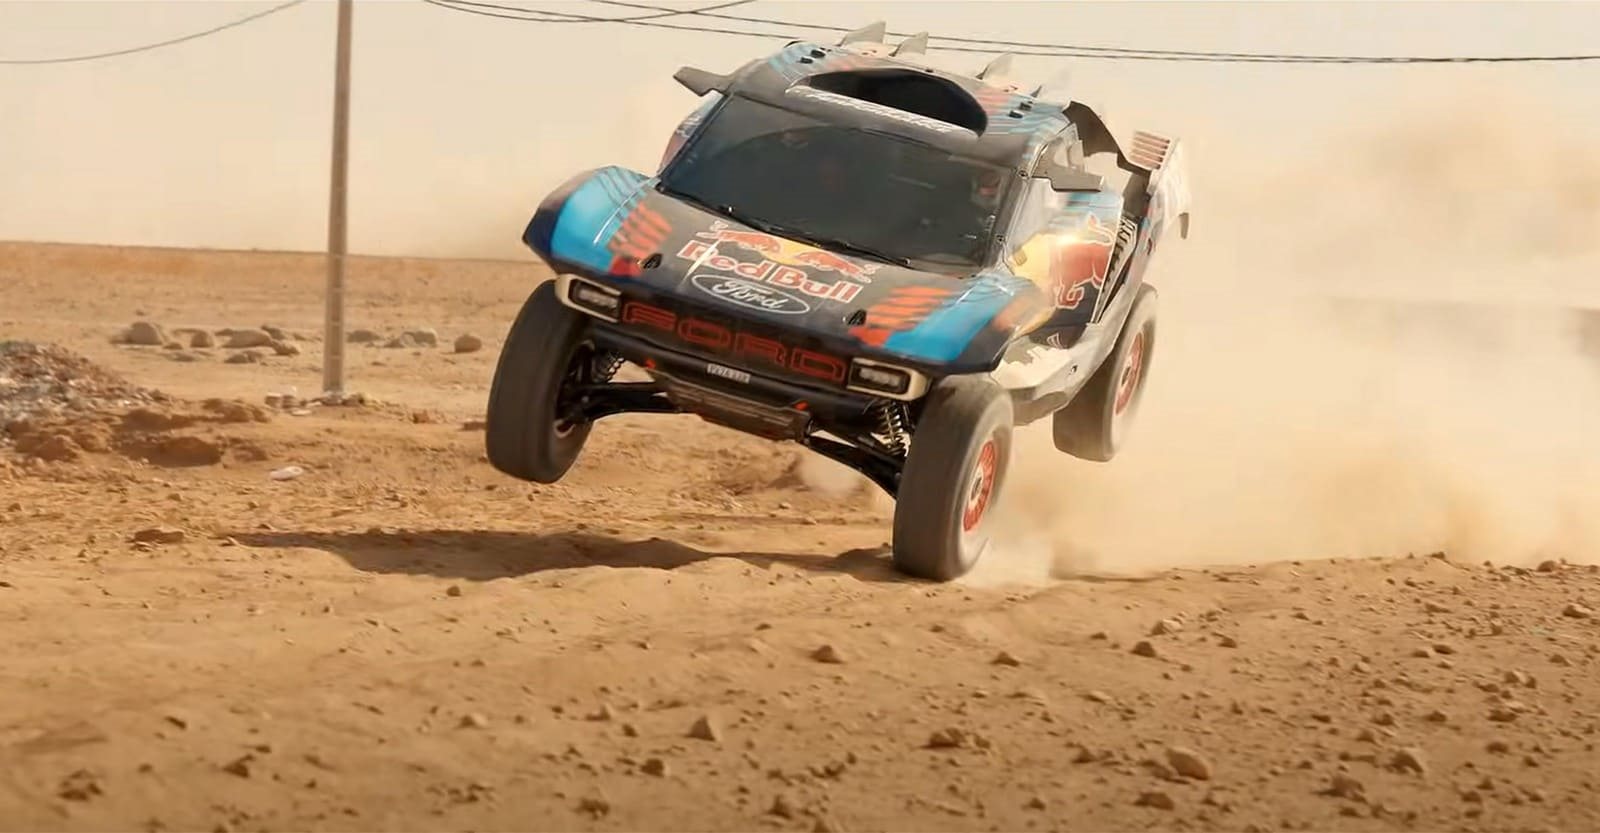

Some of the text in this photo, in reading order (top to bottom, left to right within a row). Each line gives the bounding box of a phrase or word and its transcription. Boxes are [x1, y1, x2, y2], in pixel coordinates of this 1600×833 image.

[677, 239, 863, 303] Red Bull
[711, 279, 789, 310] Ford
[623, 302, 846, 383] FORD
